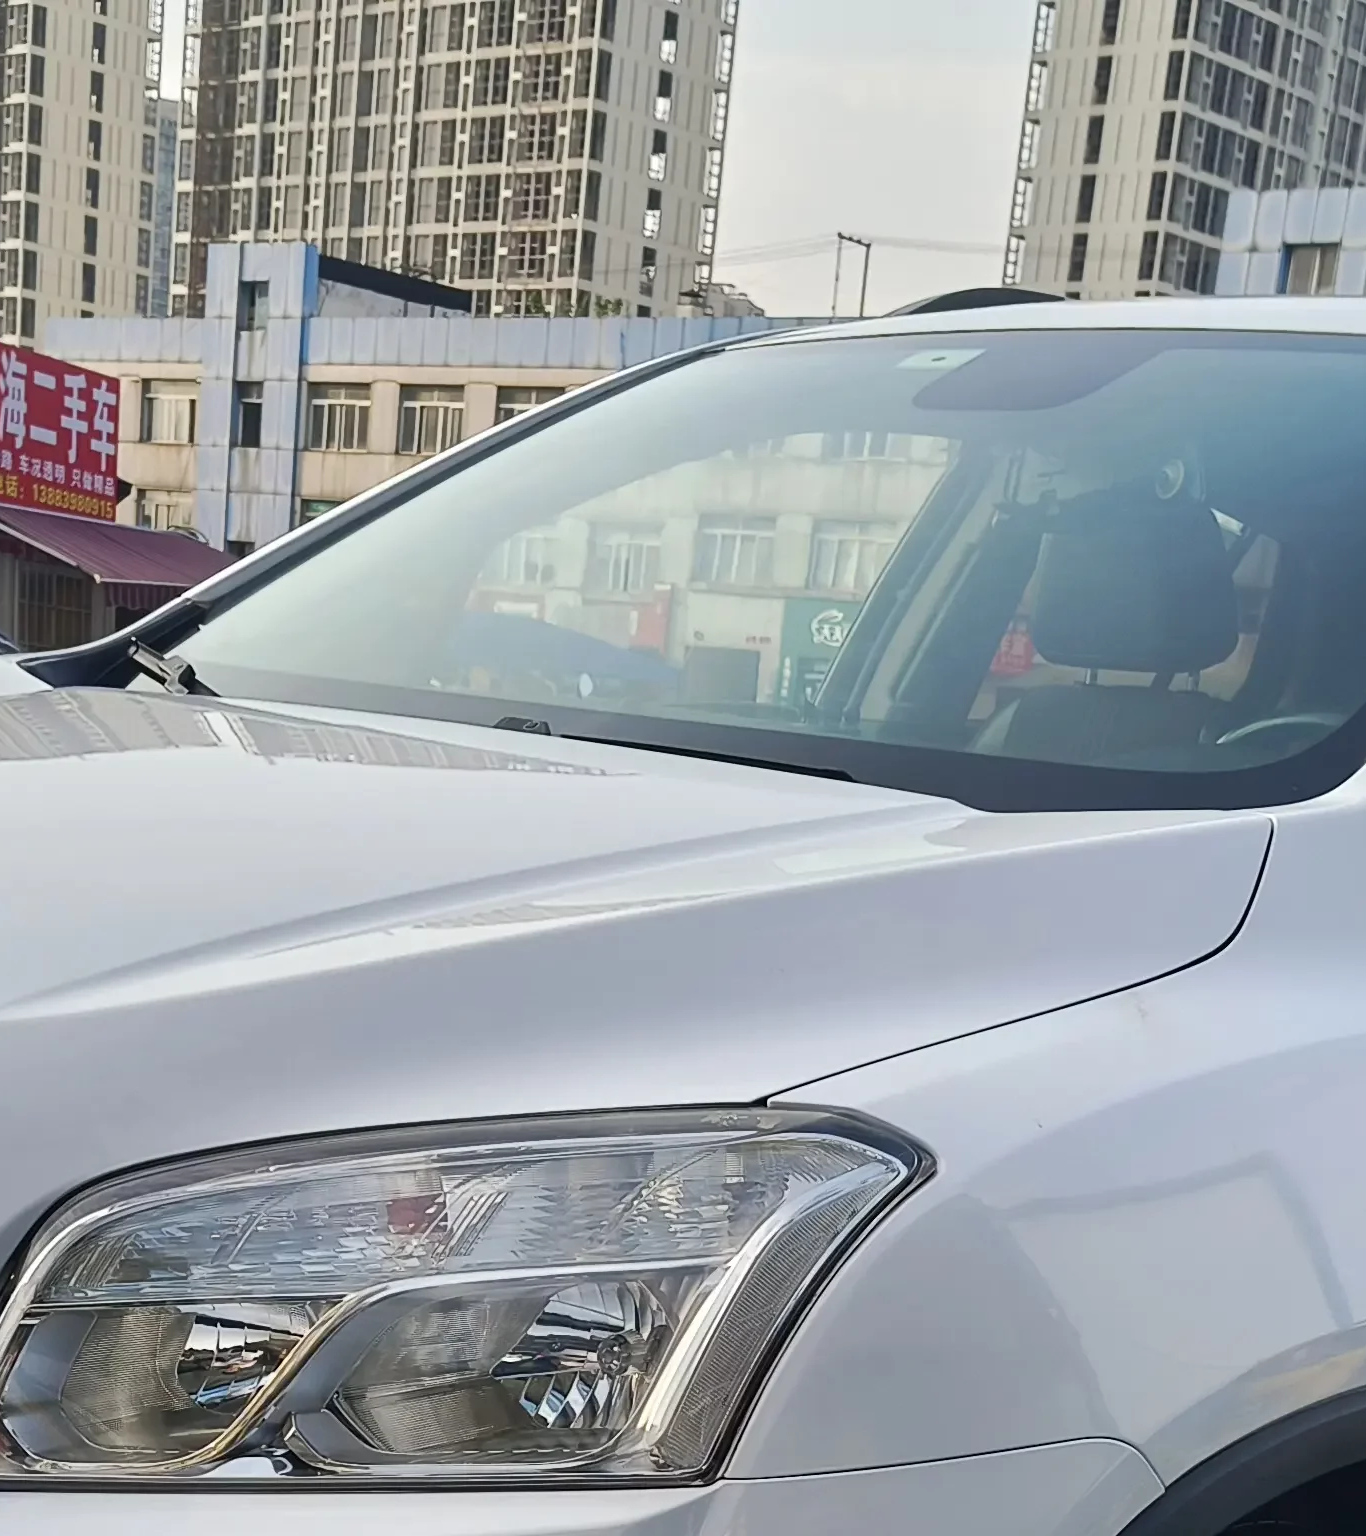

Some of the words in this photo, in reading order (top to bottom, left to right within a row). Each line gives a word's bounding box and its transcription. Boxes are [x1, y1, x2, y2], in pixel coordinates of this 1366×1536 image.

[18, 454, 66, 484] 车况透明
[70, 468, 115, 497] 只做精品
